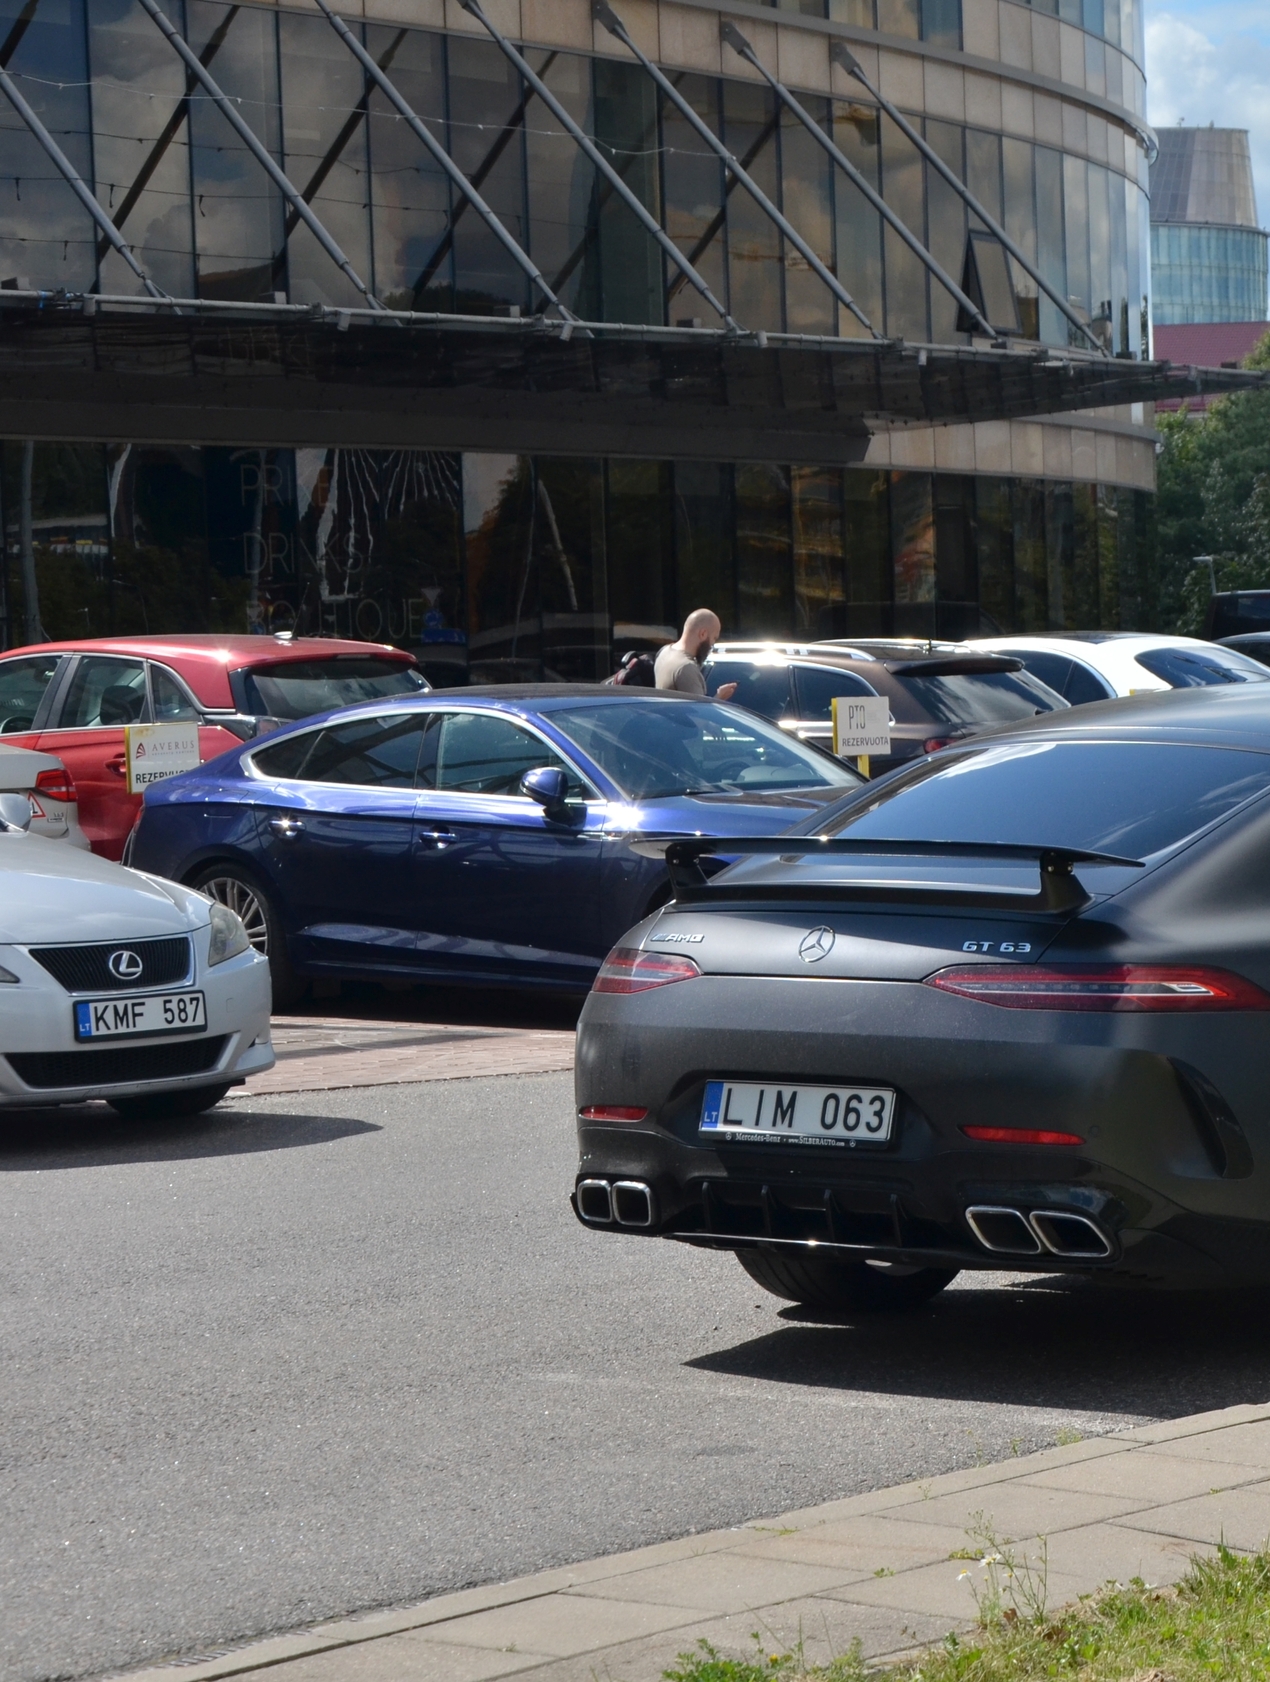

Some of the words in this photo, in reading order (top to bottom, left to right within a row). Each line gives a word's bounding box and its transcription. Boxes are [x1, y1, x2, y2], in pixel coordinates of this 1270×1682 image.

[242, 531, 363, 574] DRINKS
[848, 705, 866, 730] PTO
[152, 740, 194, 752] AVERUS
[842, 736, 889, 747] REZERVUOTA
[135, 769, 190, 784] REZER
[962, 941, 995, 952] GT
[999, 942, 1032, 953] 63
[80, 1023, 91, 1032] LT
[93, 1001, 146, 1032] KMF
[162, 996, 201, 1025] 587
[704, 1111, 718, 1122] LT
[723, 1087, 798, 1128] LIM
[820, 1092, 886, 1133] 063
[735, 1132, 781, 1143] Mercedes-Benz
